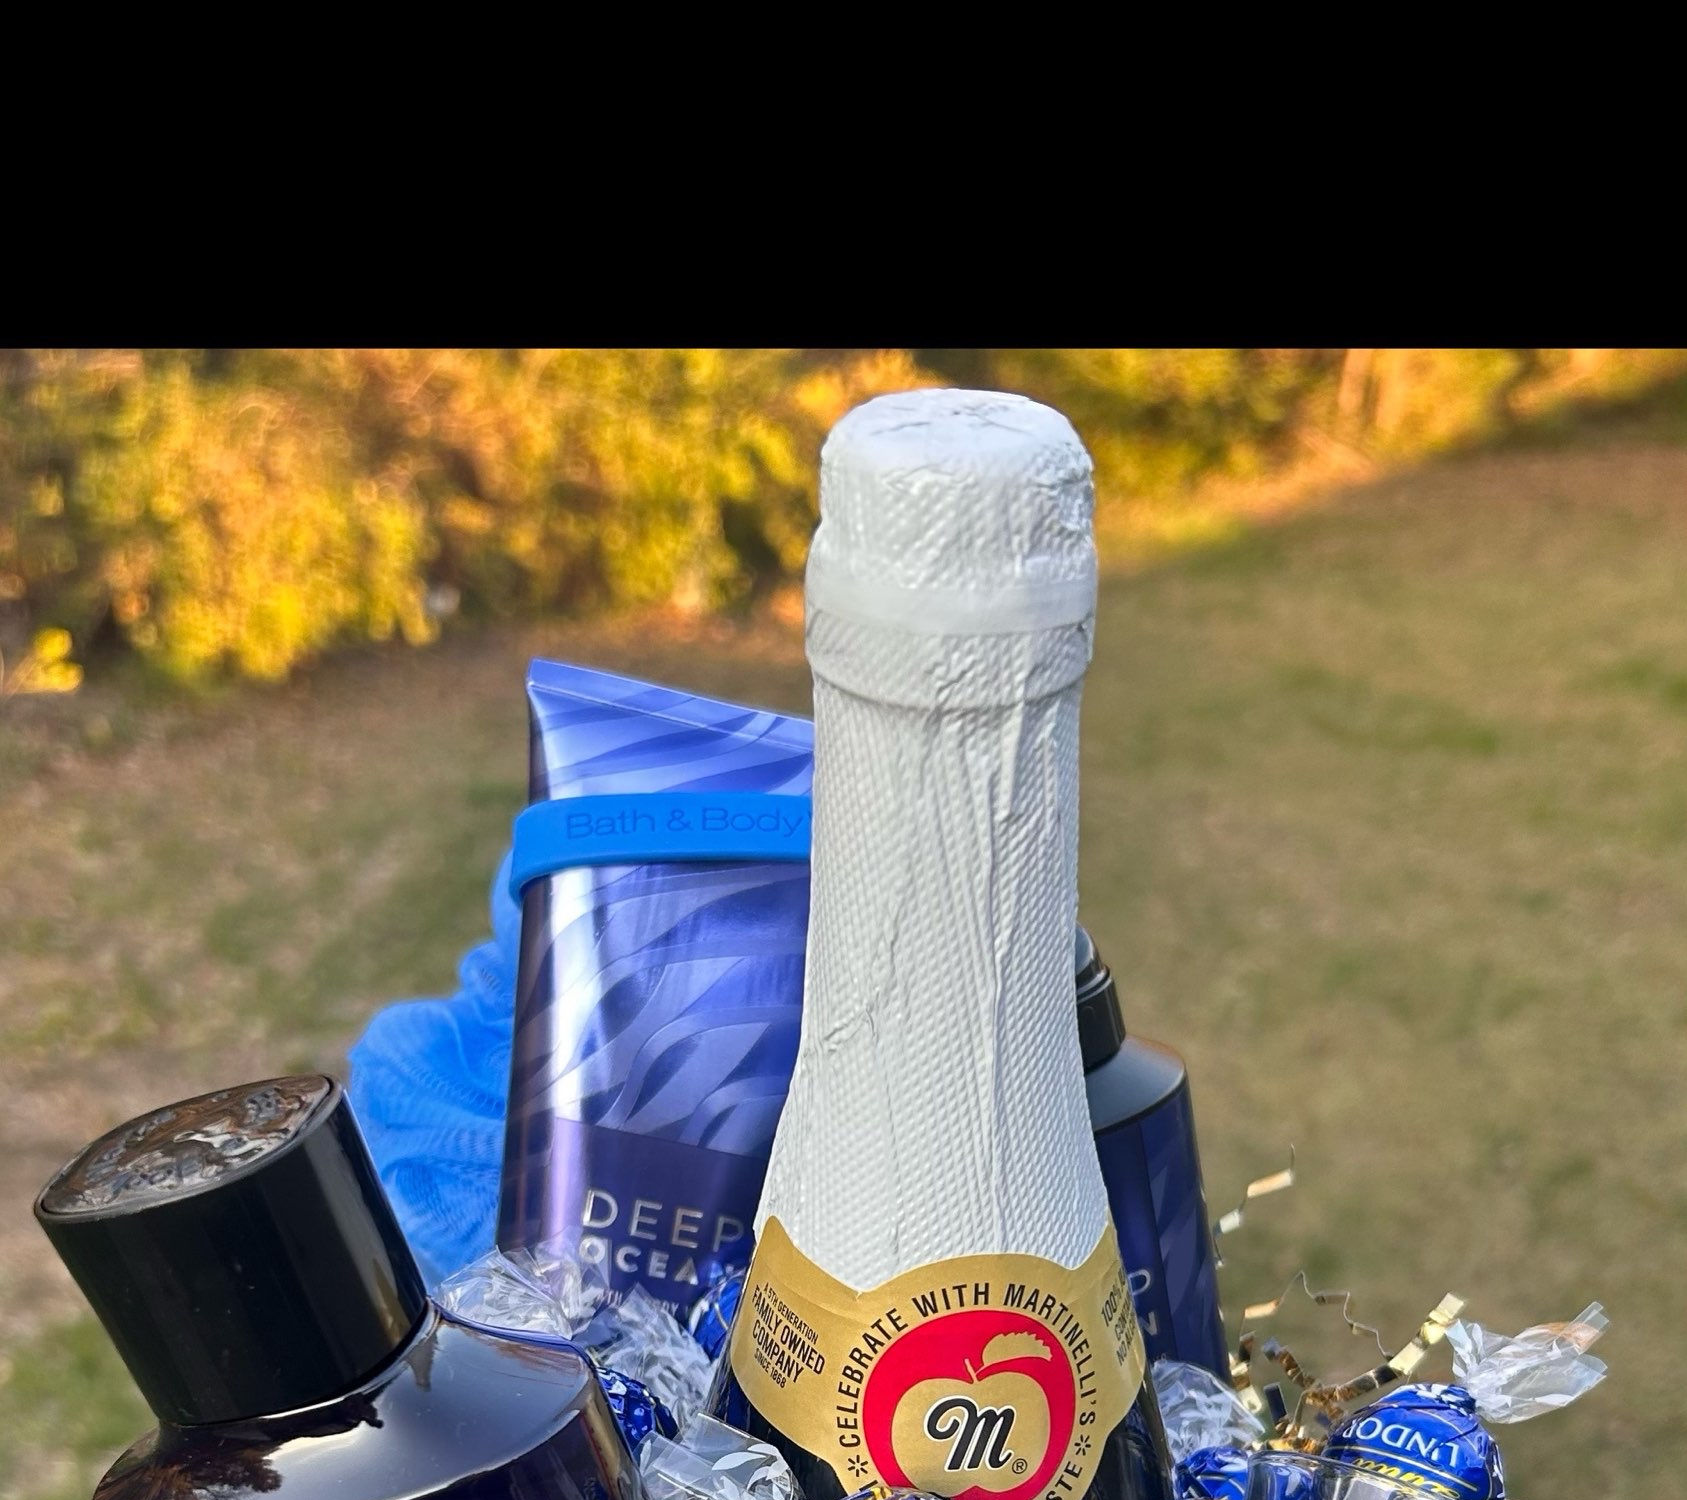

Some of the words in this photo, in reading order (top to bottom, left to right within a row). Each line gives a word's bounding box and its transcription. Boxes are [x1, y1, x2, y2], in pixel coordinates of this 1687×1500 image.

[566, 807, 656, 840] Bath
[666, 808, 695, 832] &
[701, 806, 804, 838] Body
[582, 1189, 744, 1253] DEEP
[579, 1234, 699, 1286] OCEA
[752, 1284, 783, 1336] FAMILY
[780, 1326, 826, 1376] OWNED
[752, 1318, 805, 1384] COMPANY
[777, 1299, 819, 1345] GENERATION
[754, 1347, 770, 1374] SINCE
[770, 1366, 787, 1389] 1868
[837, 1307, 909, 1449] CELEBRATE
[911, 1282, 991, 1318] WITH
[1003, 1282, 1097, 1426] MARTINELLI'S
